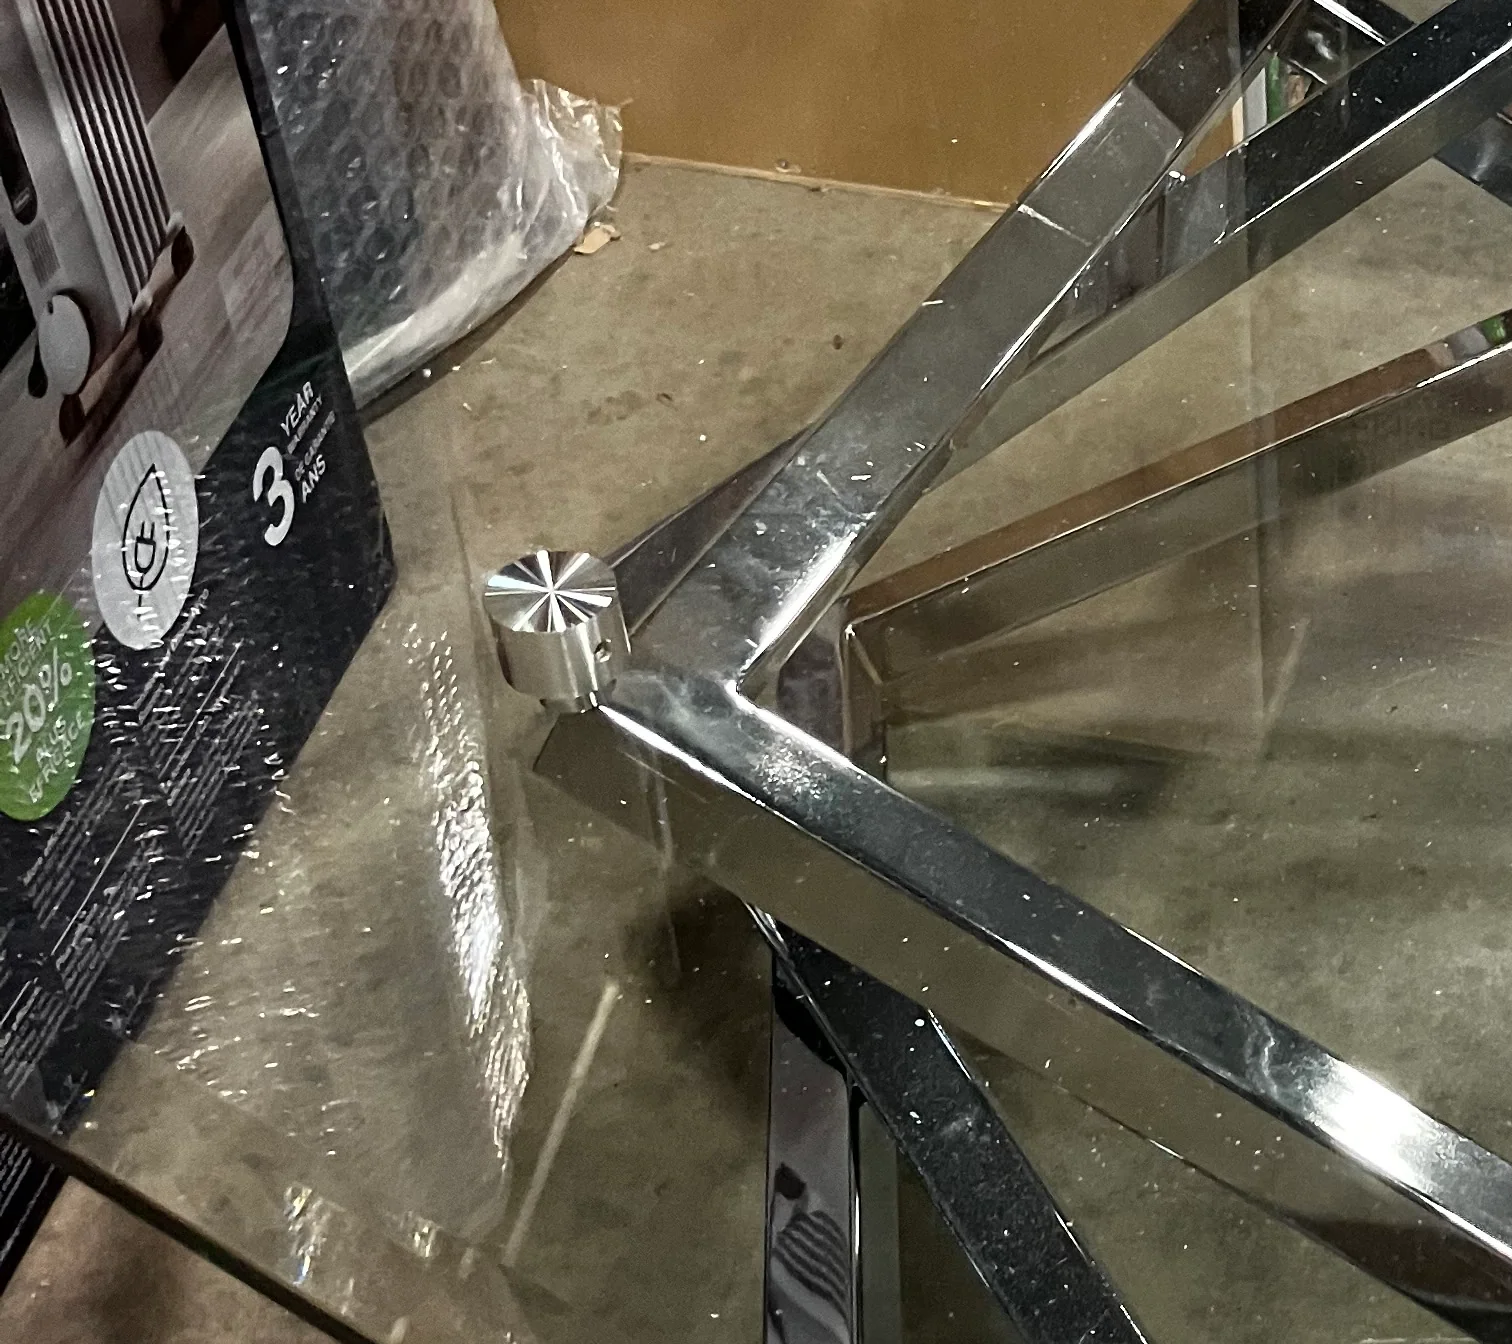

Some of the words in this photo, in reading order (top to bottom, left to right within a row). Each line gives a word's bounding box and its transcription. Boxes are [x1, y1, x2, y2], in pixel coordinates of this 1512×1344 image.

[280, 381, 314, 437] YEAR
[252, 446, 295, 546] 3
[301, 454, 326, 504] ANS
[5, 646, 72, 764] 20%
